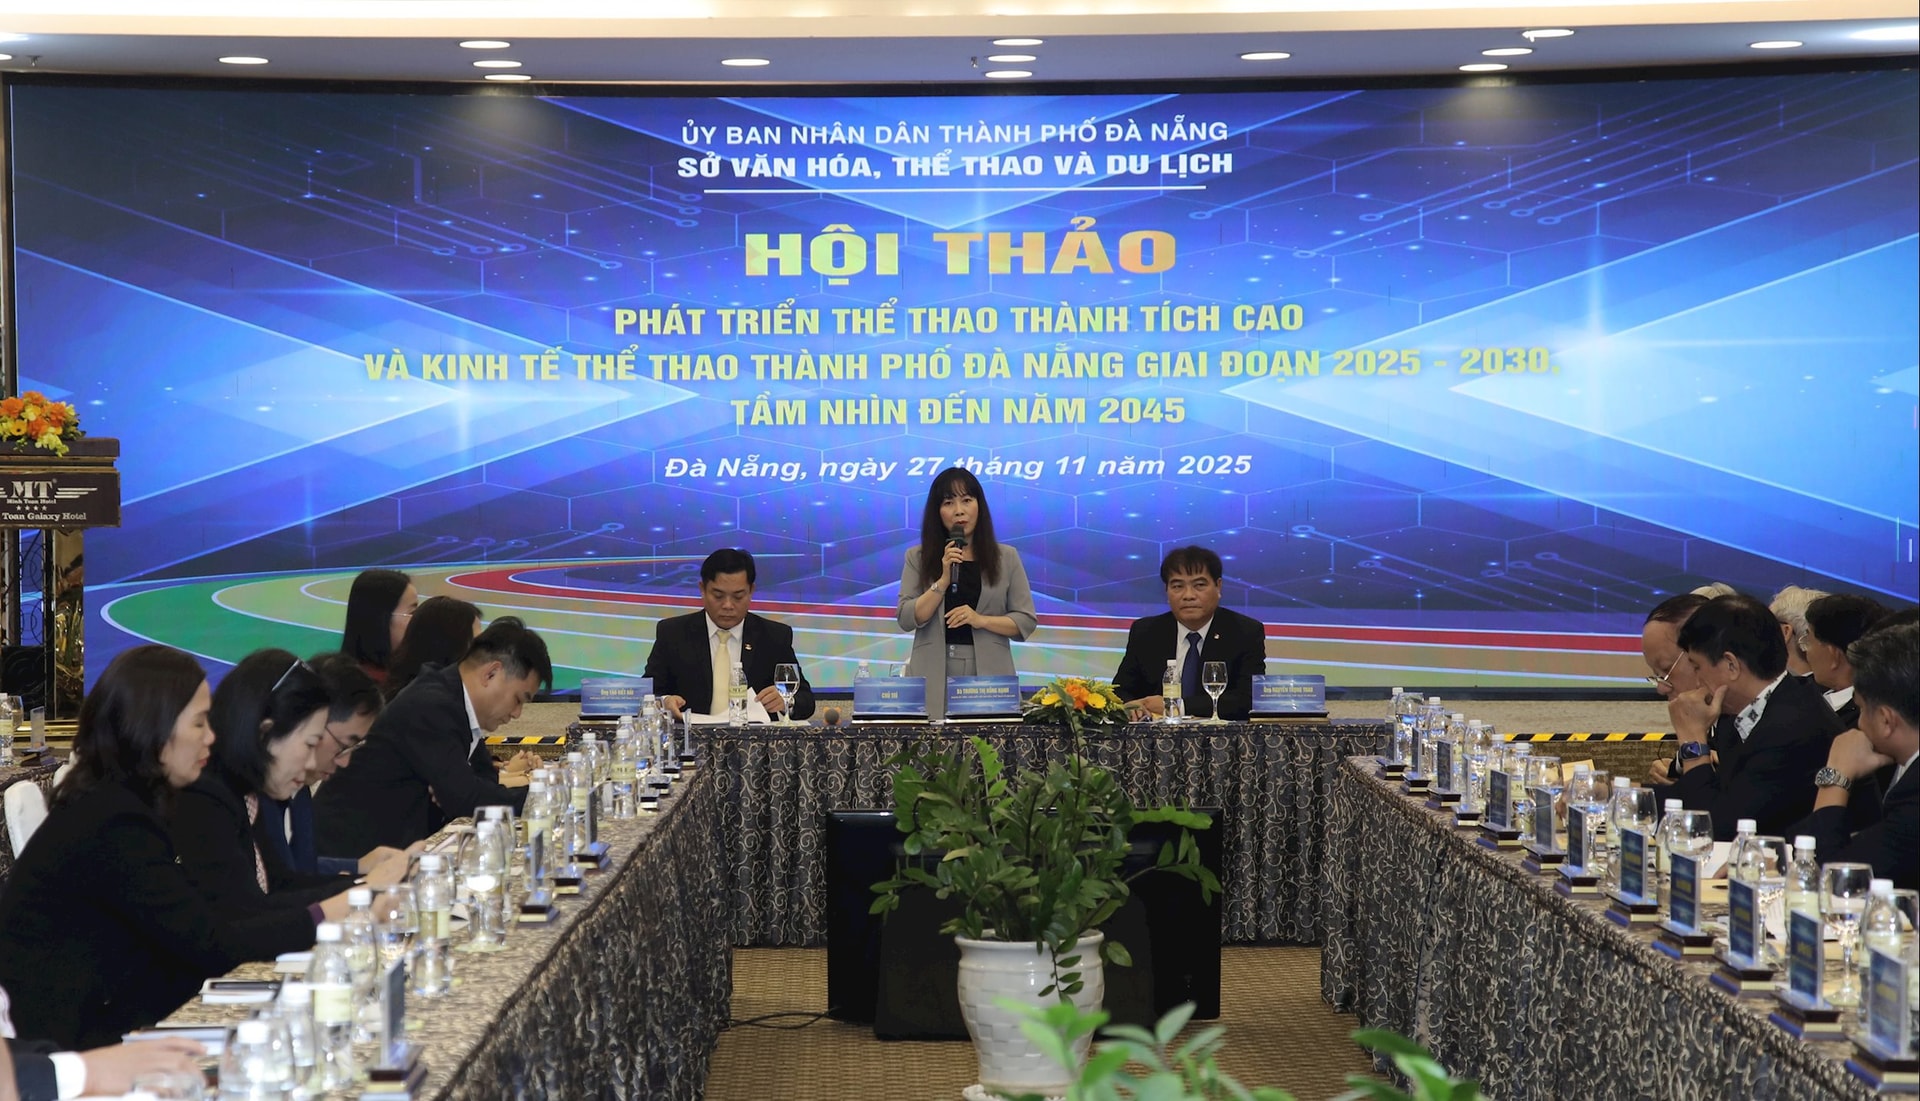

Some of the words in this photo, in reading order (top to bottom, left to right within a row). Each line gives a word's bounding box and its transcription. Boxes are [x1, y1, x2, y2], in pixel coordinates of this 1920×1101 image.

[682, 119, 717, 145] ỦY
[726, 126, 781, 145] BAN
[791, 121, 865, 144] NHÂN
[875, 121, 930, 143] DÂN
[939, 120, 1031, 143] THÀNH
[1040, 117, 1097, 142] PHỐ
[1105, 119, 1142, 141] ĐÀ
[1151, 115, 1228, 141] NẴNG
[677, 152, 721, 178] SỞ
[731, 153, 796, 177] VĂN
[807, 153, 881, 179] HÓA,
[892, 149, 953, 177] THỂ
[961, 155, 1043, 176] THAO
[1053, 151, 1096, 175] VÀ
[1106, 154, 1149, 175] DU
[1161, 153, 1233, 178] LỊCH
[744, 223, 899, 286] HỘI
[933, 216, 1176, 275] THẢO
[614, 303, 706, 335] PHÁT
[716, 298, 820, 335] TRIỂN
[831, 297, 897, 334] THỂ
[908, 307, 998, 333] THAO
[1010, 301, 1129, 333] THÀNH
[1140, 300, 1221, 332] TÍCH
[1232, 304, 1304, 332] CAO
[364, 348, 410, 380] VÀ
[422, 354, 508, 380] KINH
[519, 346, 563, 380] TẾ
[572, 344, 639, 380] THỂ
[648, 353, 739, 380] THAO
[750, 348, 868, 380] THÀNH
[881, 344, 952, 380] PHỐ
[963, 347, 1011, 379] ĐÀ
[1023, 342, 1124, 379] NẴNG
[1136, 351, 1208, 378] GIAI
[1220, 350, 1320, 383] ĐOẠN
[1332, 349, 1422, 376] 2025
[730, 391, 806, 425] TẦM
[819, 393, 907, 424] NHÌN
[918, 390, 991, 424] ĐẾN
[1003, 392, 1086, 424] NĂM
[1099, 397, 1186, 423] 2045
[664, 457, 707, 477] Đà
[716, 454, 808, 481] Nẵng,
[818, 458, 898, 481] ngày
[907, 457, 945, 476] 27
[953, 456, 1044, 480] tháng
[1055, 456, 1084, 475] 11
[1097, 457, 1165, 475] năm
[1177, 455, 1253, 475] 2025
[11, 481, 53, 498] MT
[2, 512, 25, 520] Toan
[27, 512, 61, 522] Galaxy
[62, 512, 87, 520] Hotel
